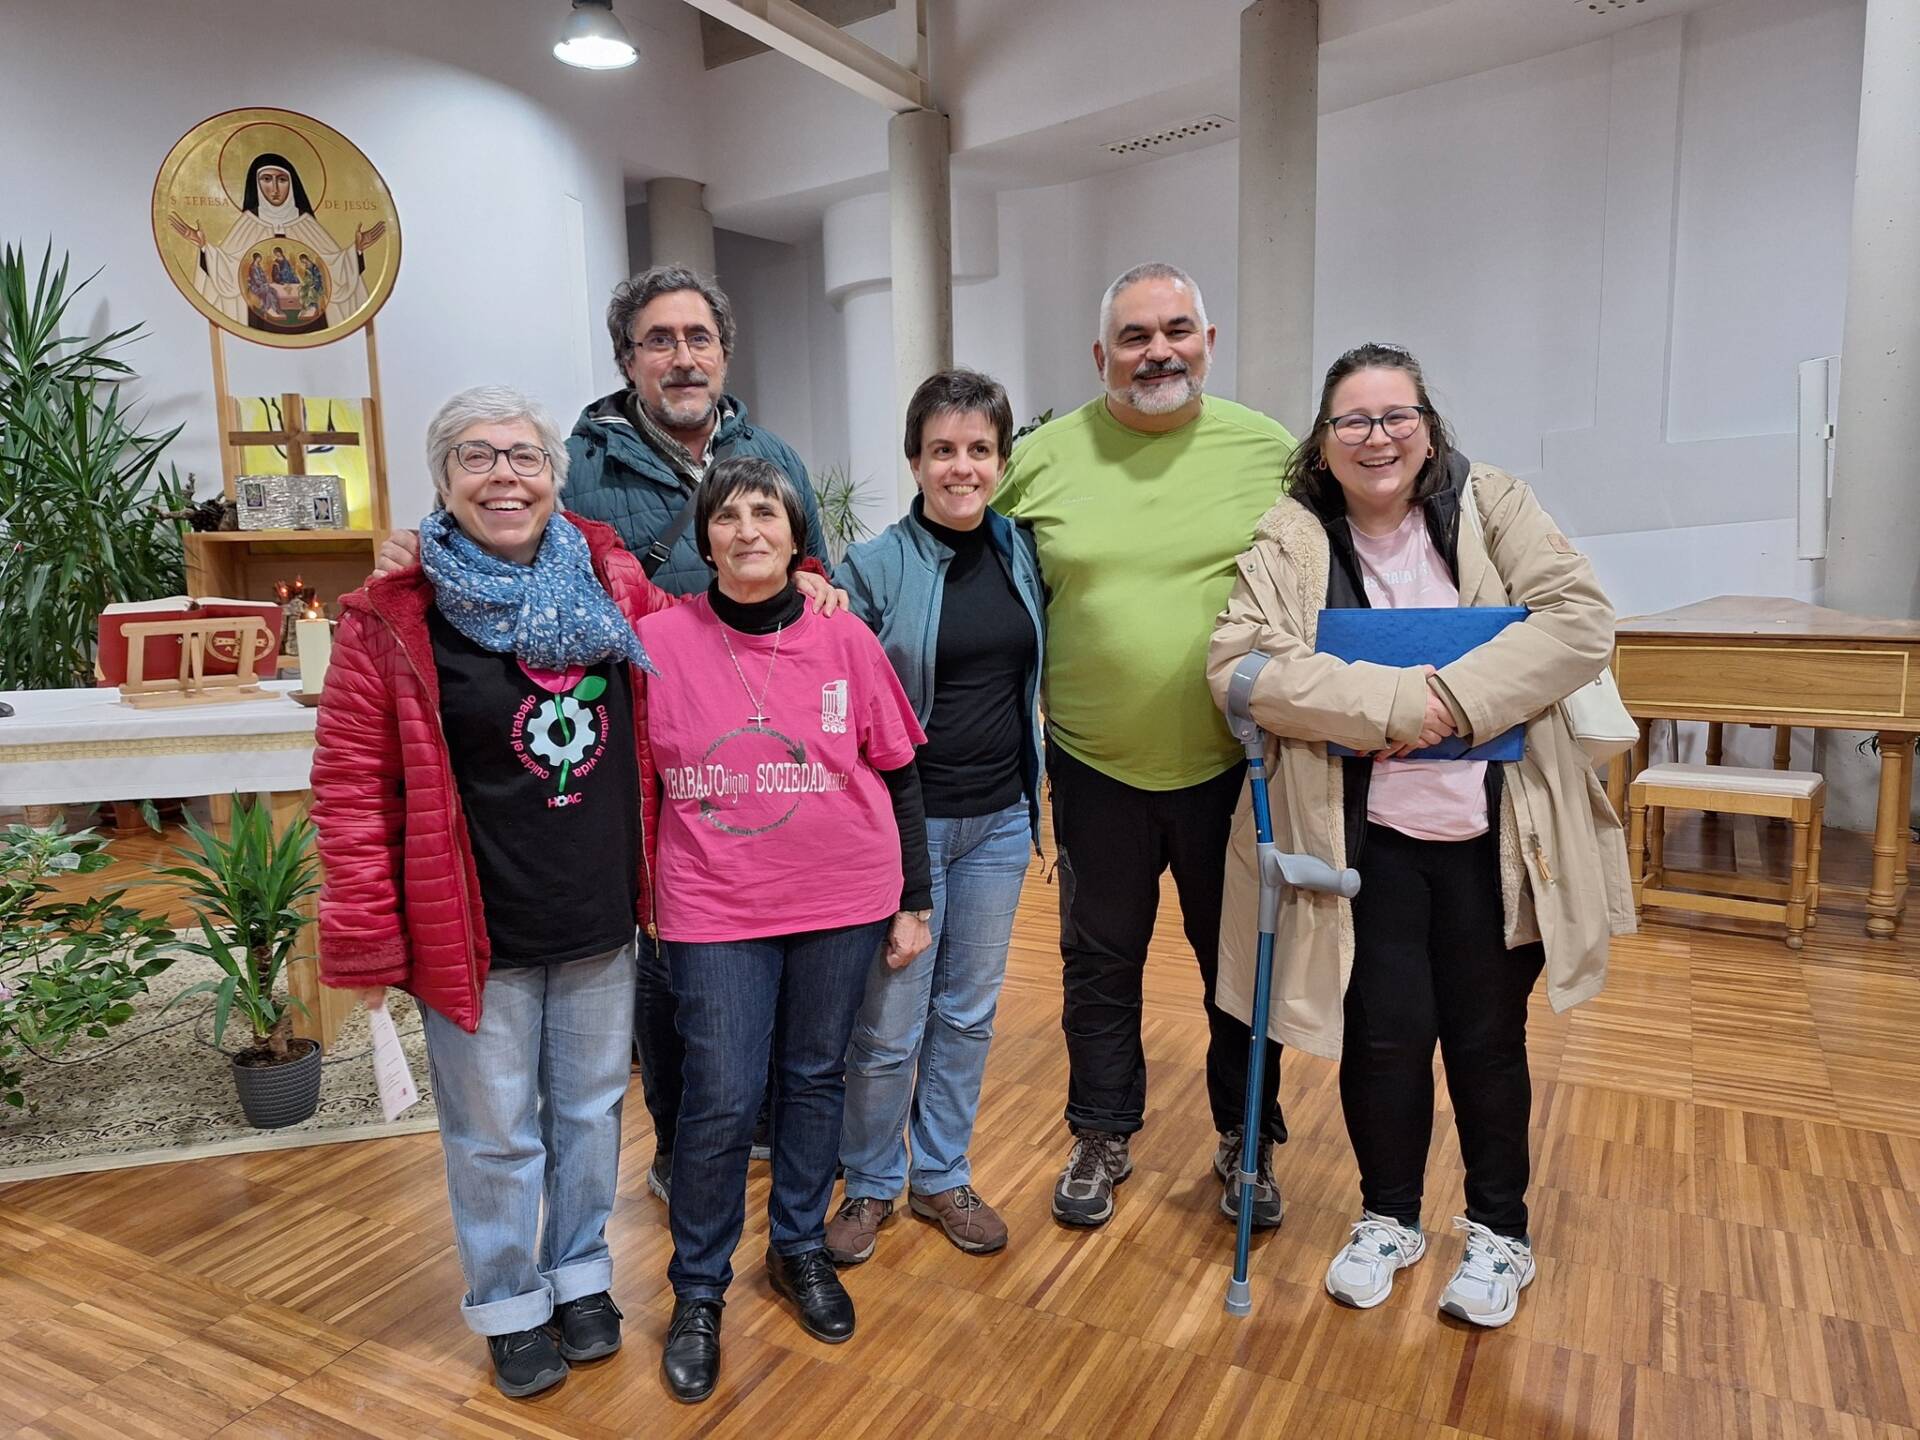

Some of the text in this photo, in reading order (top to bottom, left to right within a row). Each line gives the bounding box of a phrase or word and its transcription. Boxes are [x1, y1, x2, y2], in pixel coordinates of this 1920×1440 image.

[184, 196, 230, 207] TERESA
[324, 198, 377, 211] DE JESÚS
[510, 694, 550, 779] cuidar el trabajo
[572, 757, 598, 778] vida
